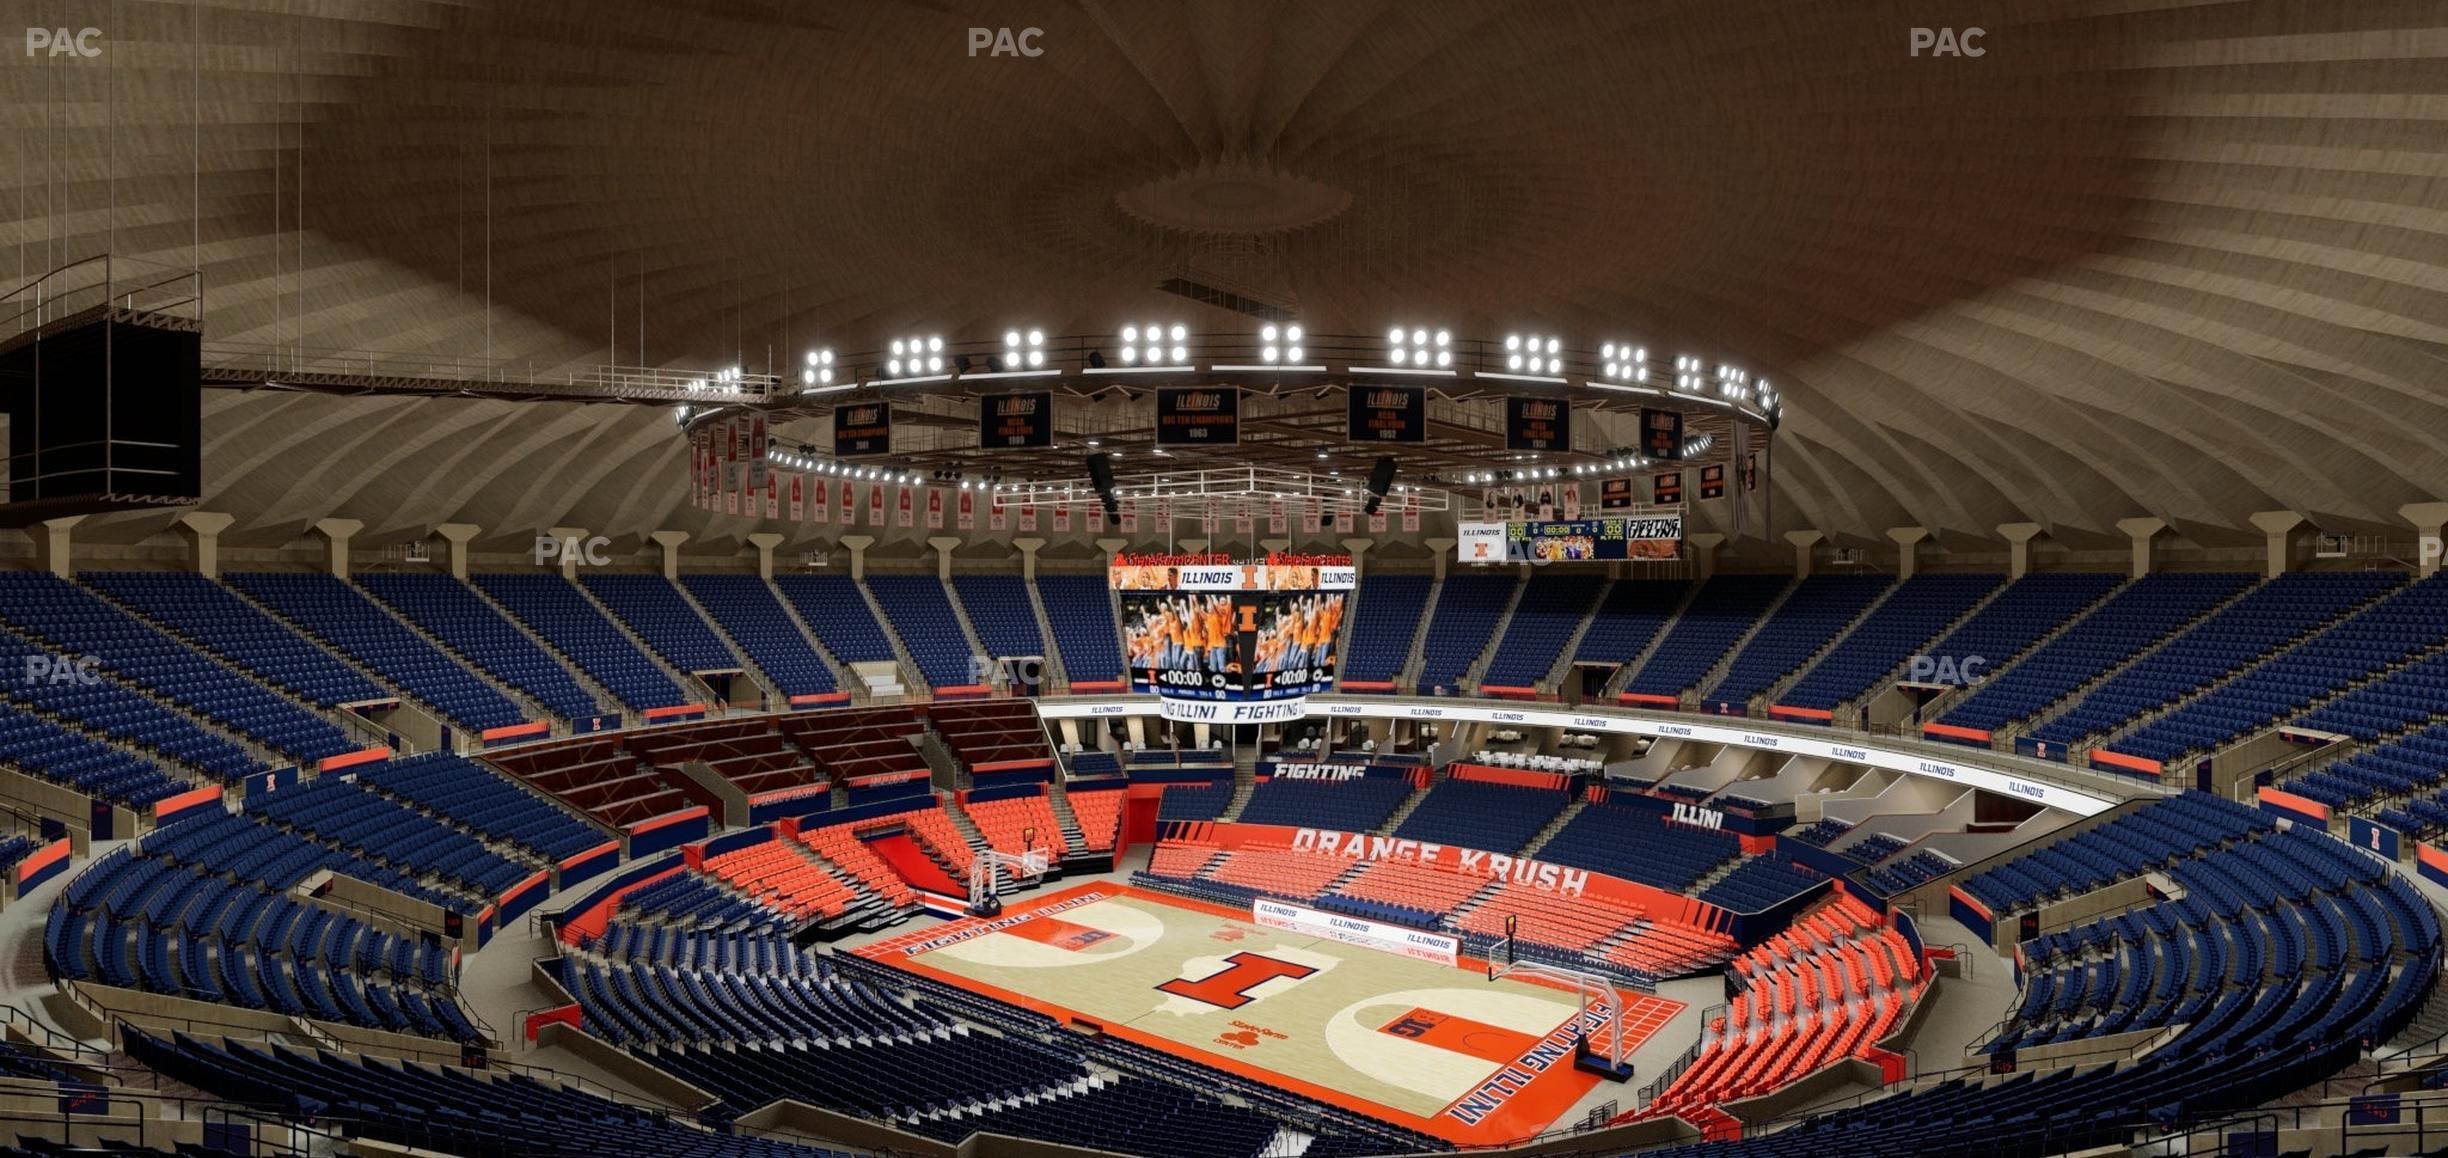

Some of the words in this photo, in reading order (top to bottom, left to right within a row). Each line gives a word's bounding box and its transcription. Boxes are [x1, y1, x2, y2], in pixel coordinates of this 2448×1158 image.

[1182, 572, 1233, 584] ILLINOIS
[1321, 572, 1355, 584] ILLINOIS
[1168, 669, 1203, 686] 00:00
[1281, 668, 1308, 685] 00:00
[1091, 706, 1124, 714] ILLINOIS
[1177, 703, 1218, 719] ILLINI
[1233, 702, 1298, 720] FIGHTING
[1329, 705, 1362, 715] ILLINOIS
[1410, 708, 1443, 717] ILLINOIS
[1491, 712, 1525, 721] ILLINOIS
[1573, 717, 1608, 728] ILLINOIS
[1658, 725, 1692, 737] ILLINOIS
[1743, 734, 1779, 747] ILLINOIS
[1831, 746, 1867, 761] ILLINOIS
[1273, 763, 1367, 781] FIGHTING
[1920, 762, 1956, 778] ILLINOIS
[2008, 781, 2045, 799] ILLINOIS
[1672, 802, 1724, 830] ILLINI
[1291, 828, 1441, 864] ORANGE
[1458, 847, 1589, 897] KRUSH
[1260, 904, 1298, 918] ILLINOIS
[1329, 917, 1370, 933] ILLINOIS
[1407, 933, 1451, 950] ILLINOIS
[1445, 1066, 1537, 1127] ILLINI
